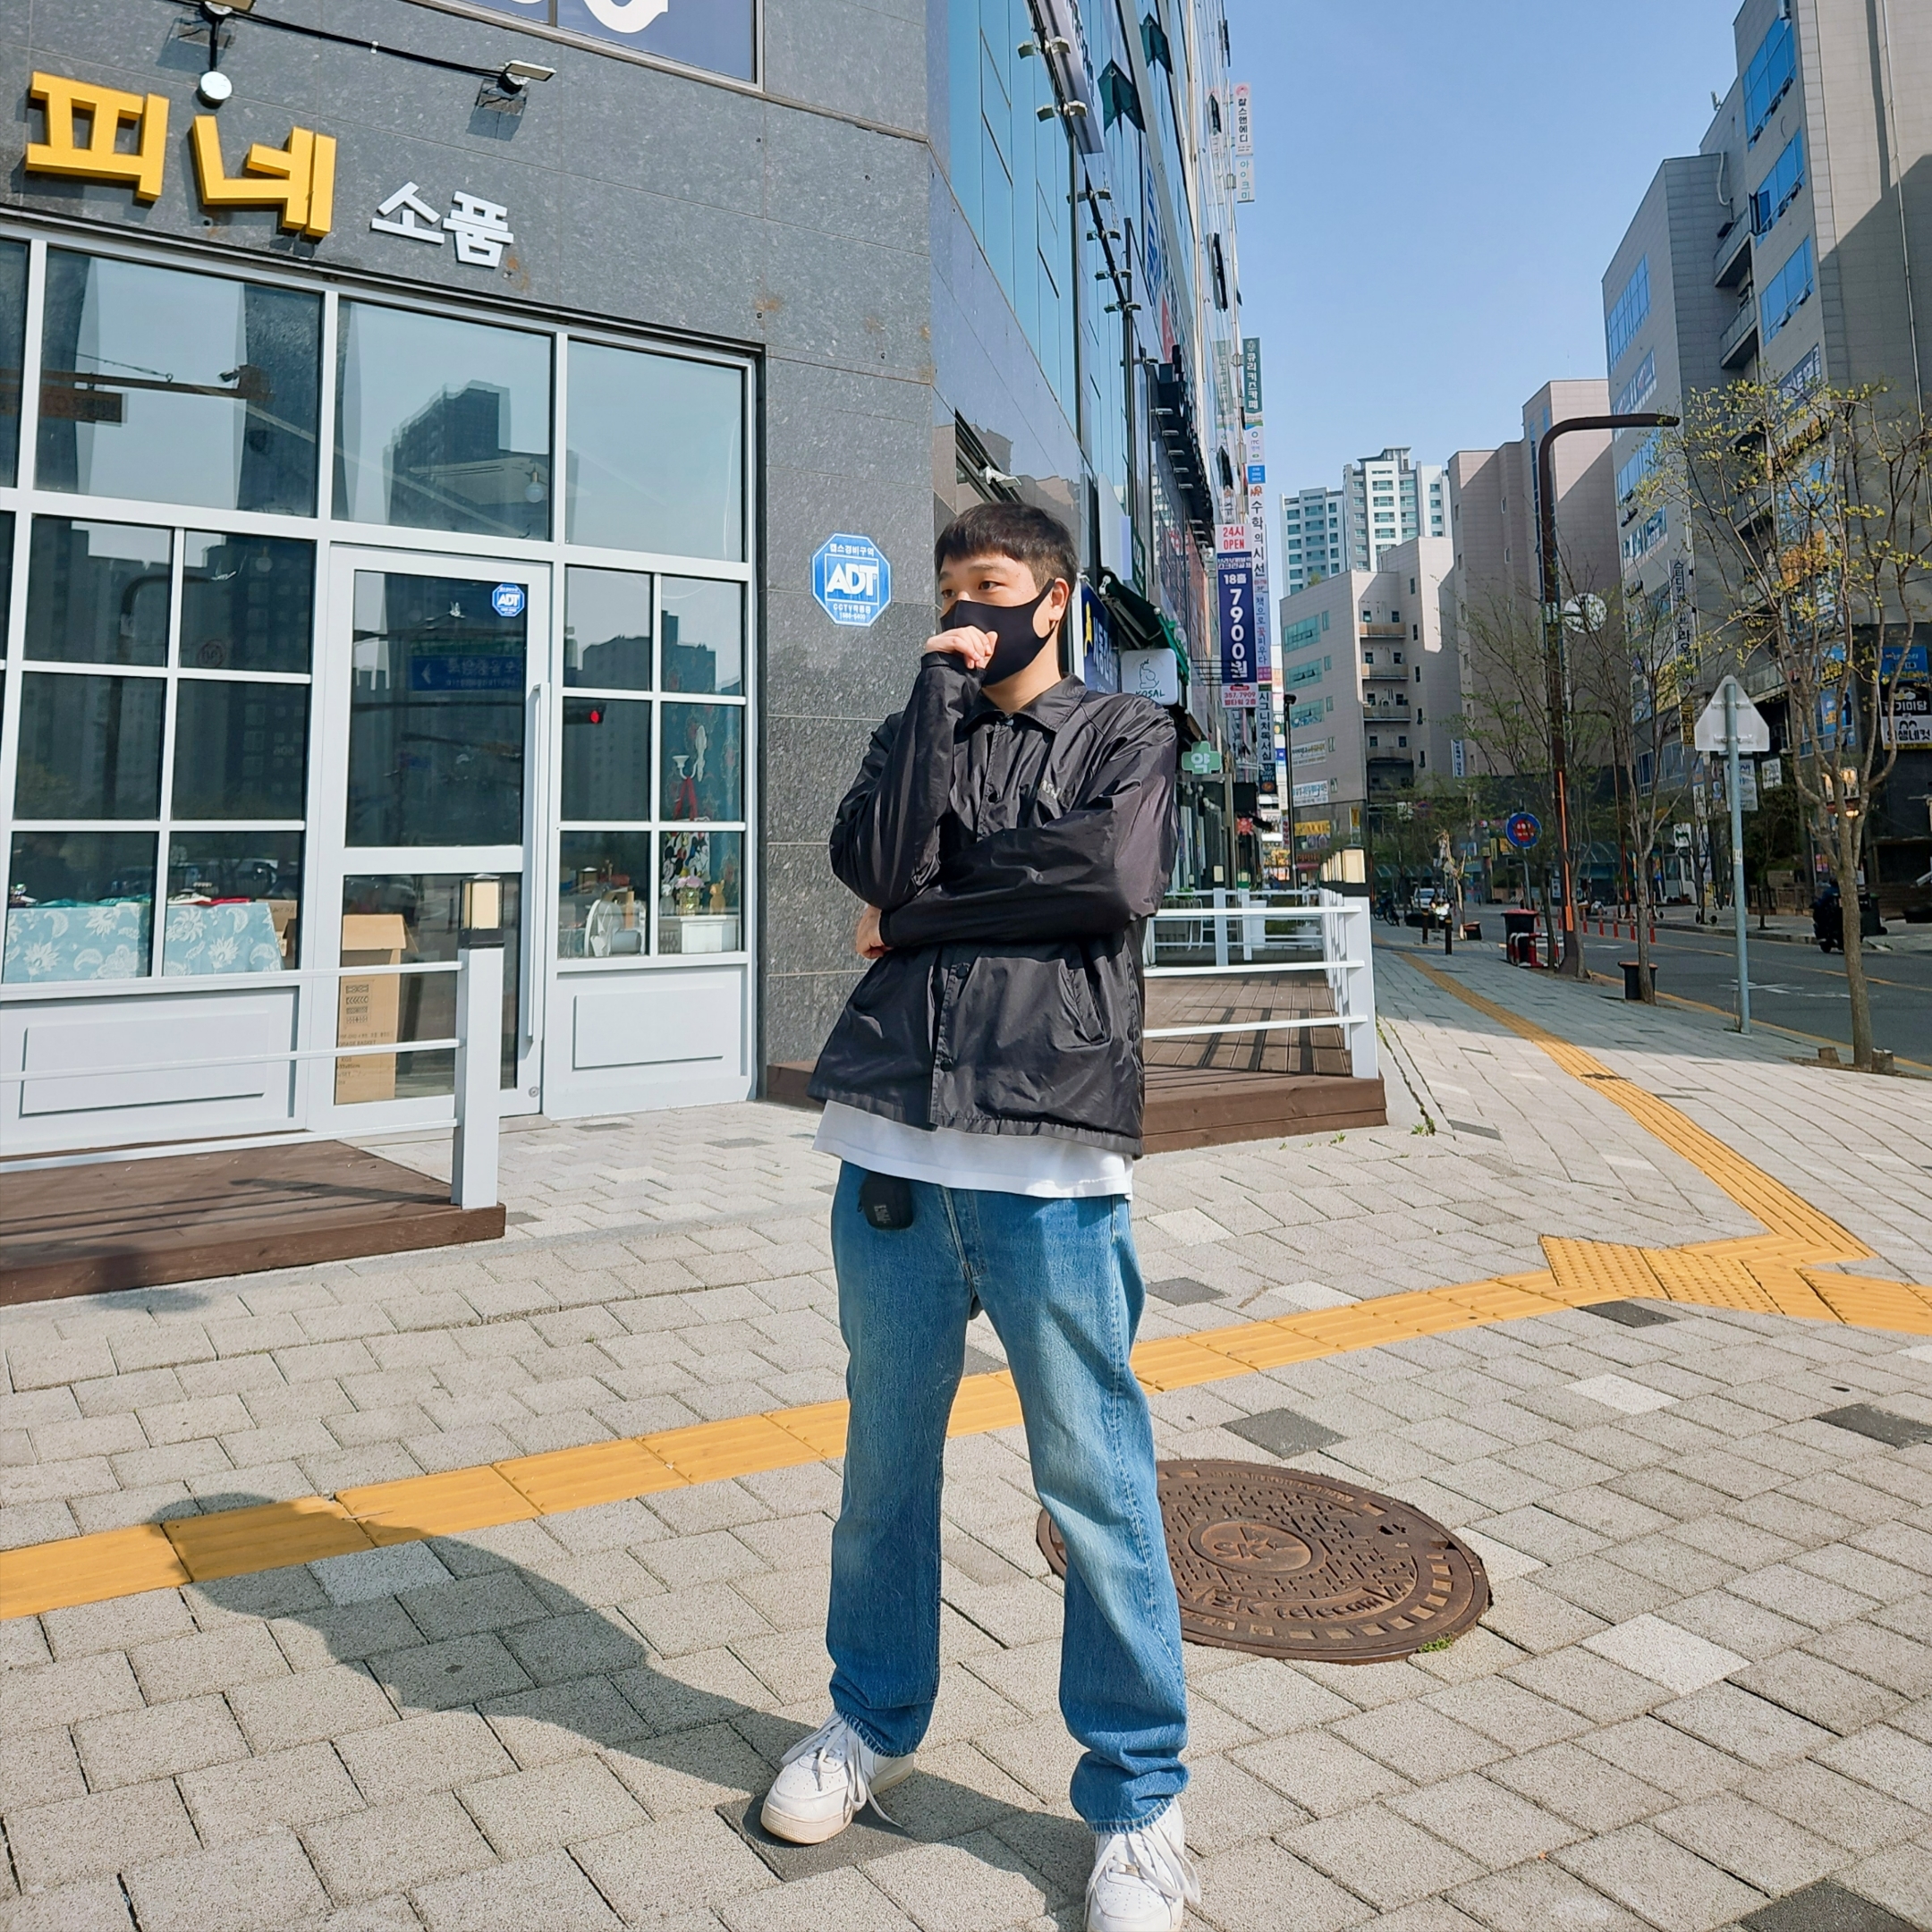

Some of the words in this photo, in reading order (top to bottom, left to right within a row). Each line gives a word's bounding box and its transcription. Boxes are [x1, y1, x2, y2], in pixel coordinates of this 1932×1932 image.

[370, 181, 514, 268] 소품
[1223, 526, 1244, 538] 24시
[1224, 539, 1245, 550] OPEN
[826, 563, 877, 597] ADT
[497, 593, 521, 606] ADT
[1191, 753, 1210, 774] 약
[1274, 1596, 1385, 1620] telecom
